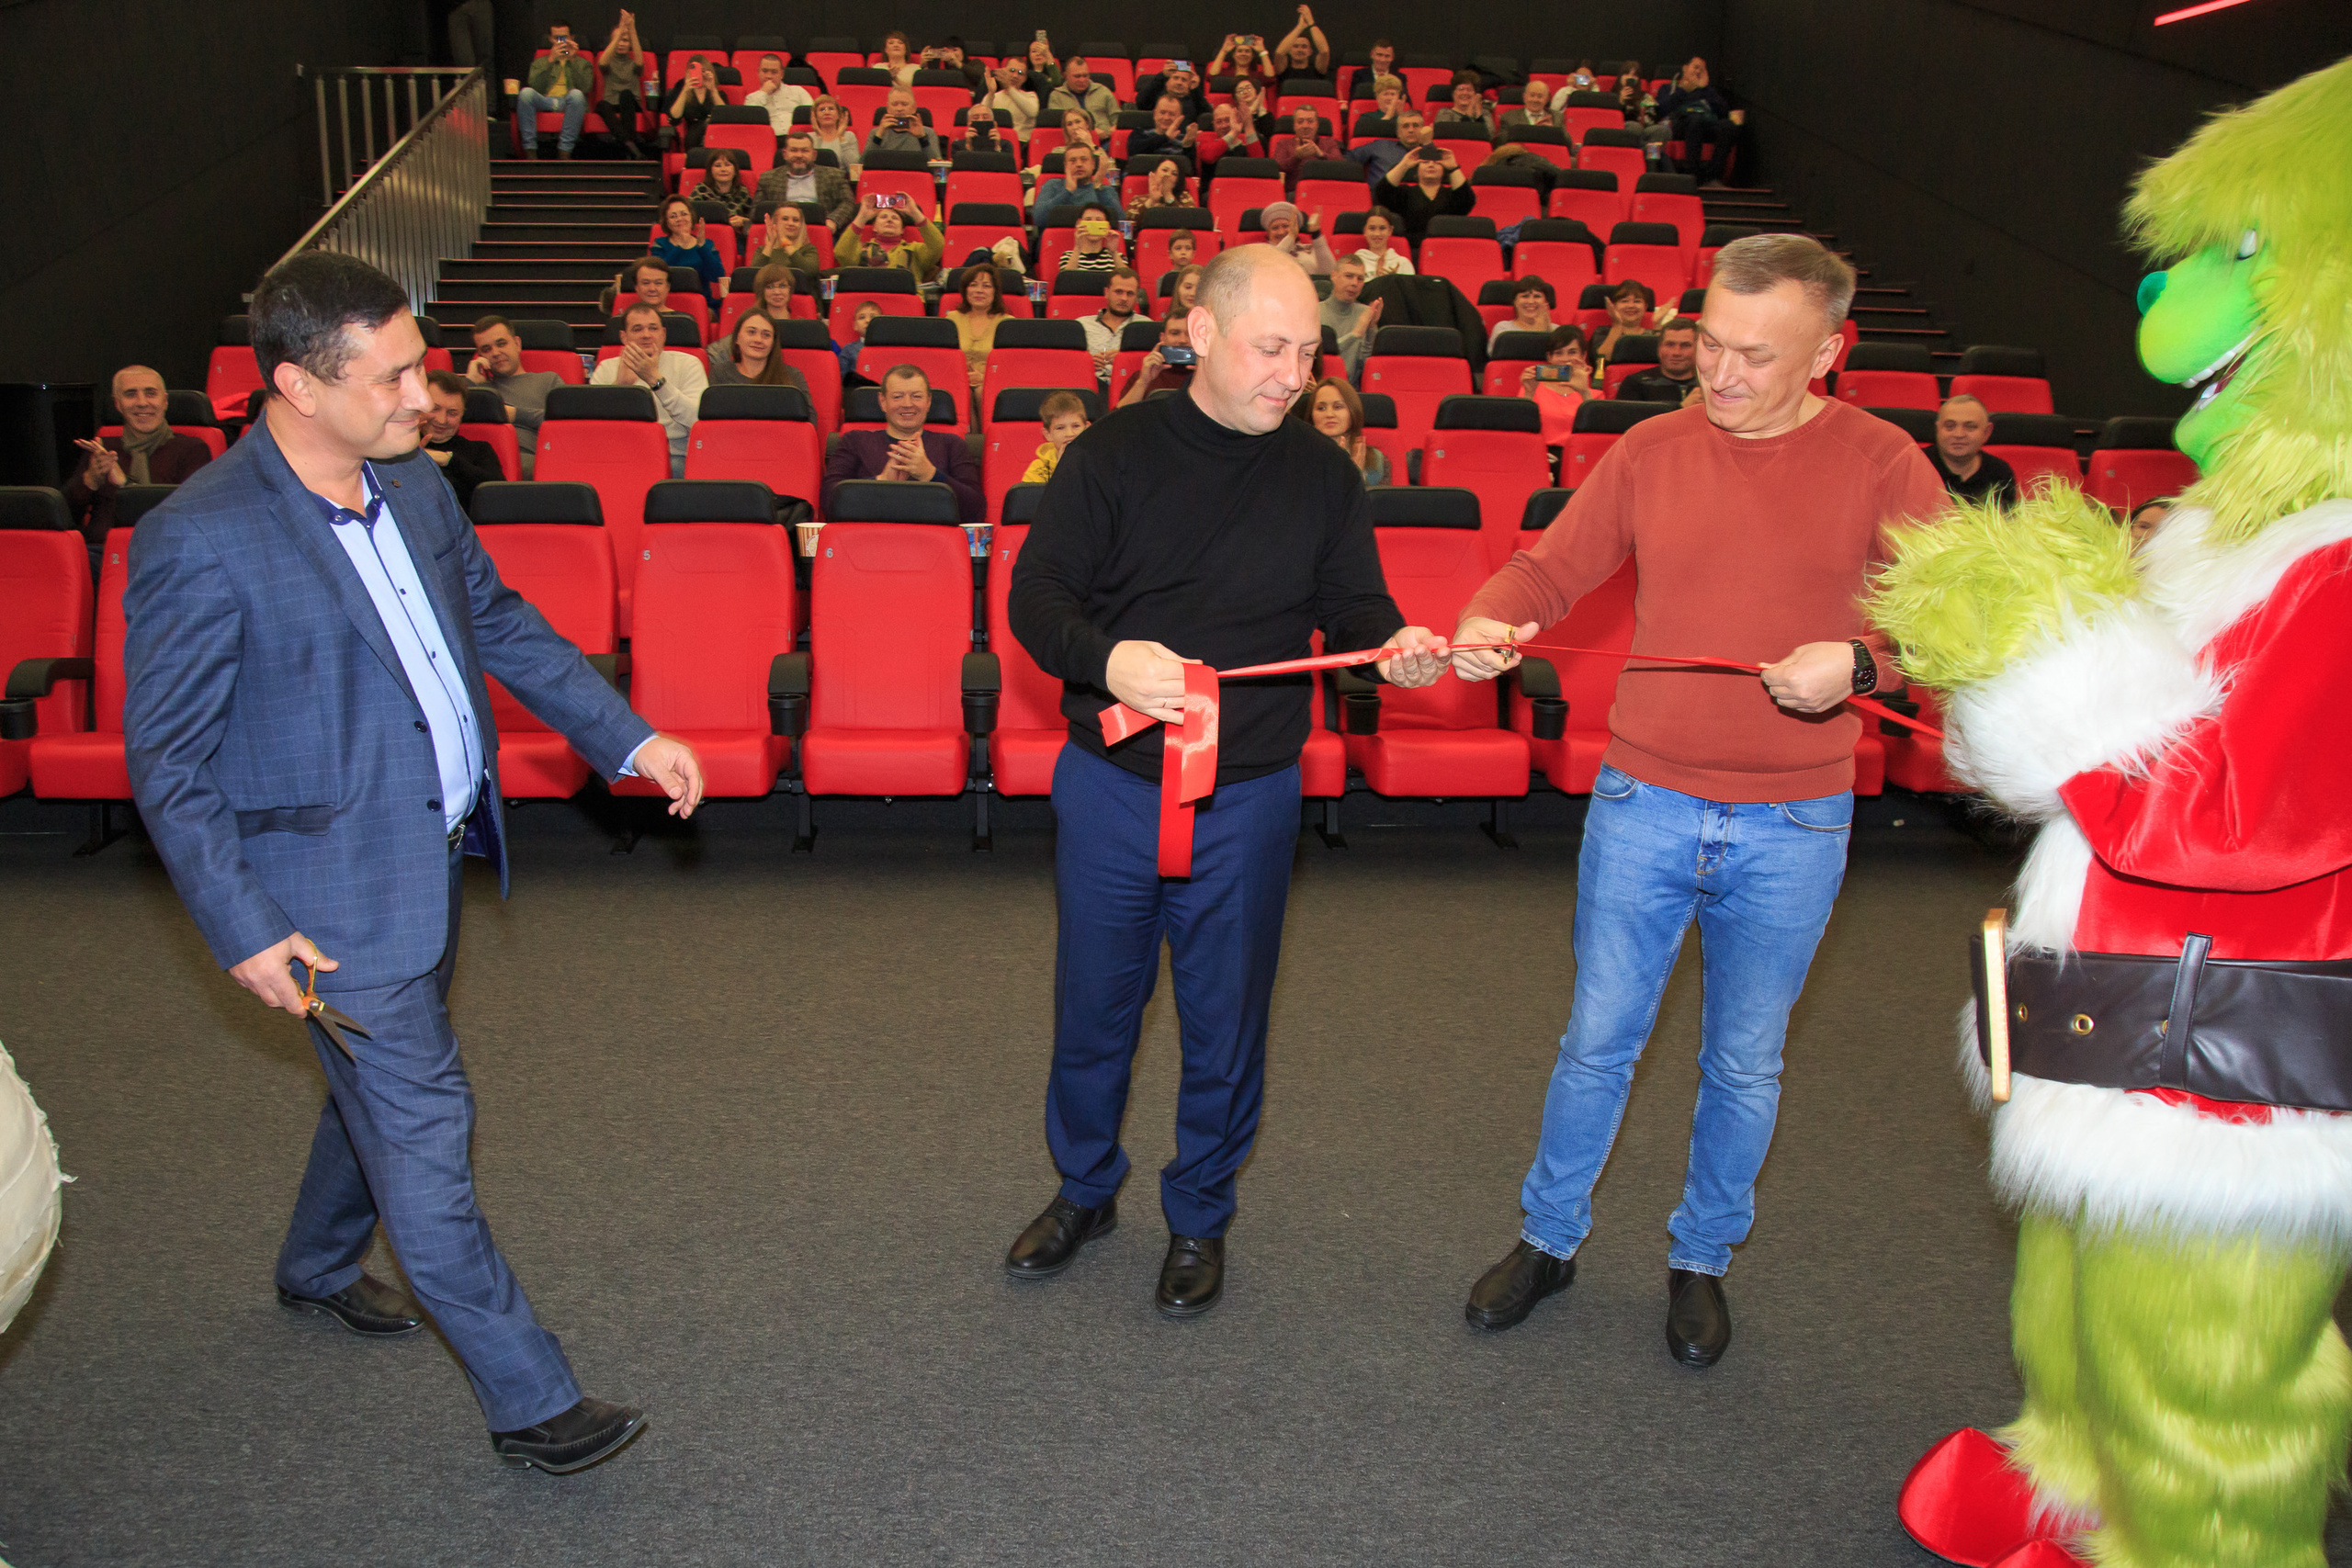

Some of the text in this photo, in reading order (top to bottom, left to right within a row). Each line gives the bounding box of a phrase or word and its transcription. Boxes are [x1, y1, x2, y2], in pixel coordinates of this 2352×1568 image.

[864, 364, 871, 372] 6
[991, 364, 999, 374] 7
[543, 441, 551, 451] 4
[695, 439, 703, 449] 5
[992, 442, 1001, 452] 7
[642, 549, 651, 561] 5
[825, 547, 834, 558] 6
[1001, 549, 1011, 561] 7
[111, 552, 120, 565] 2
